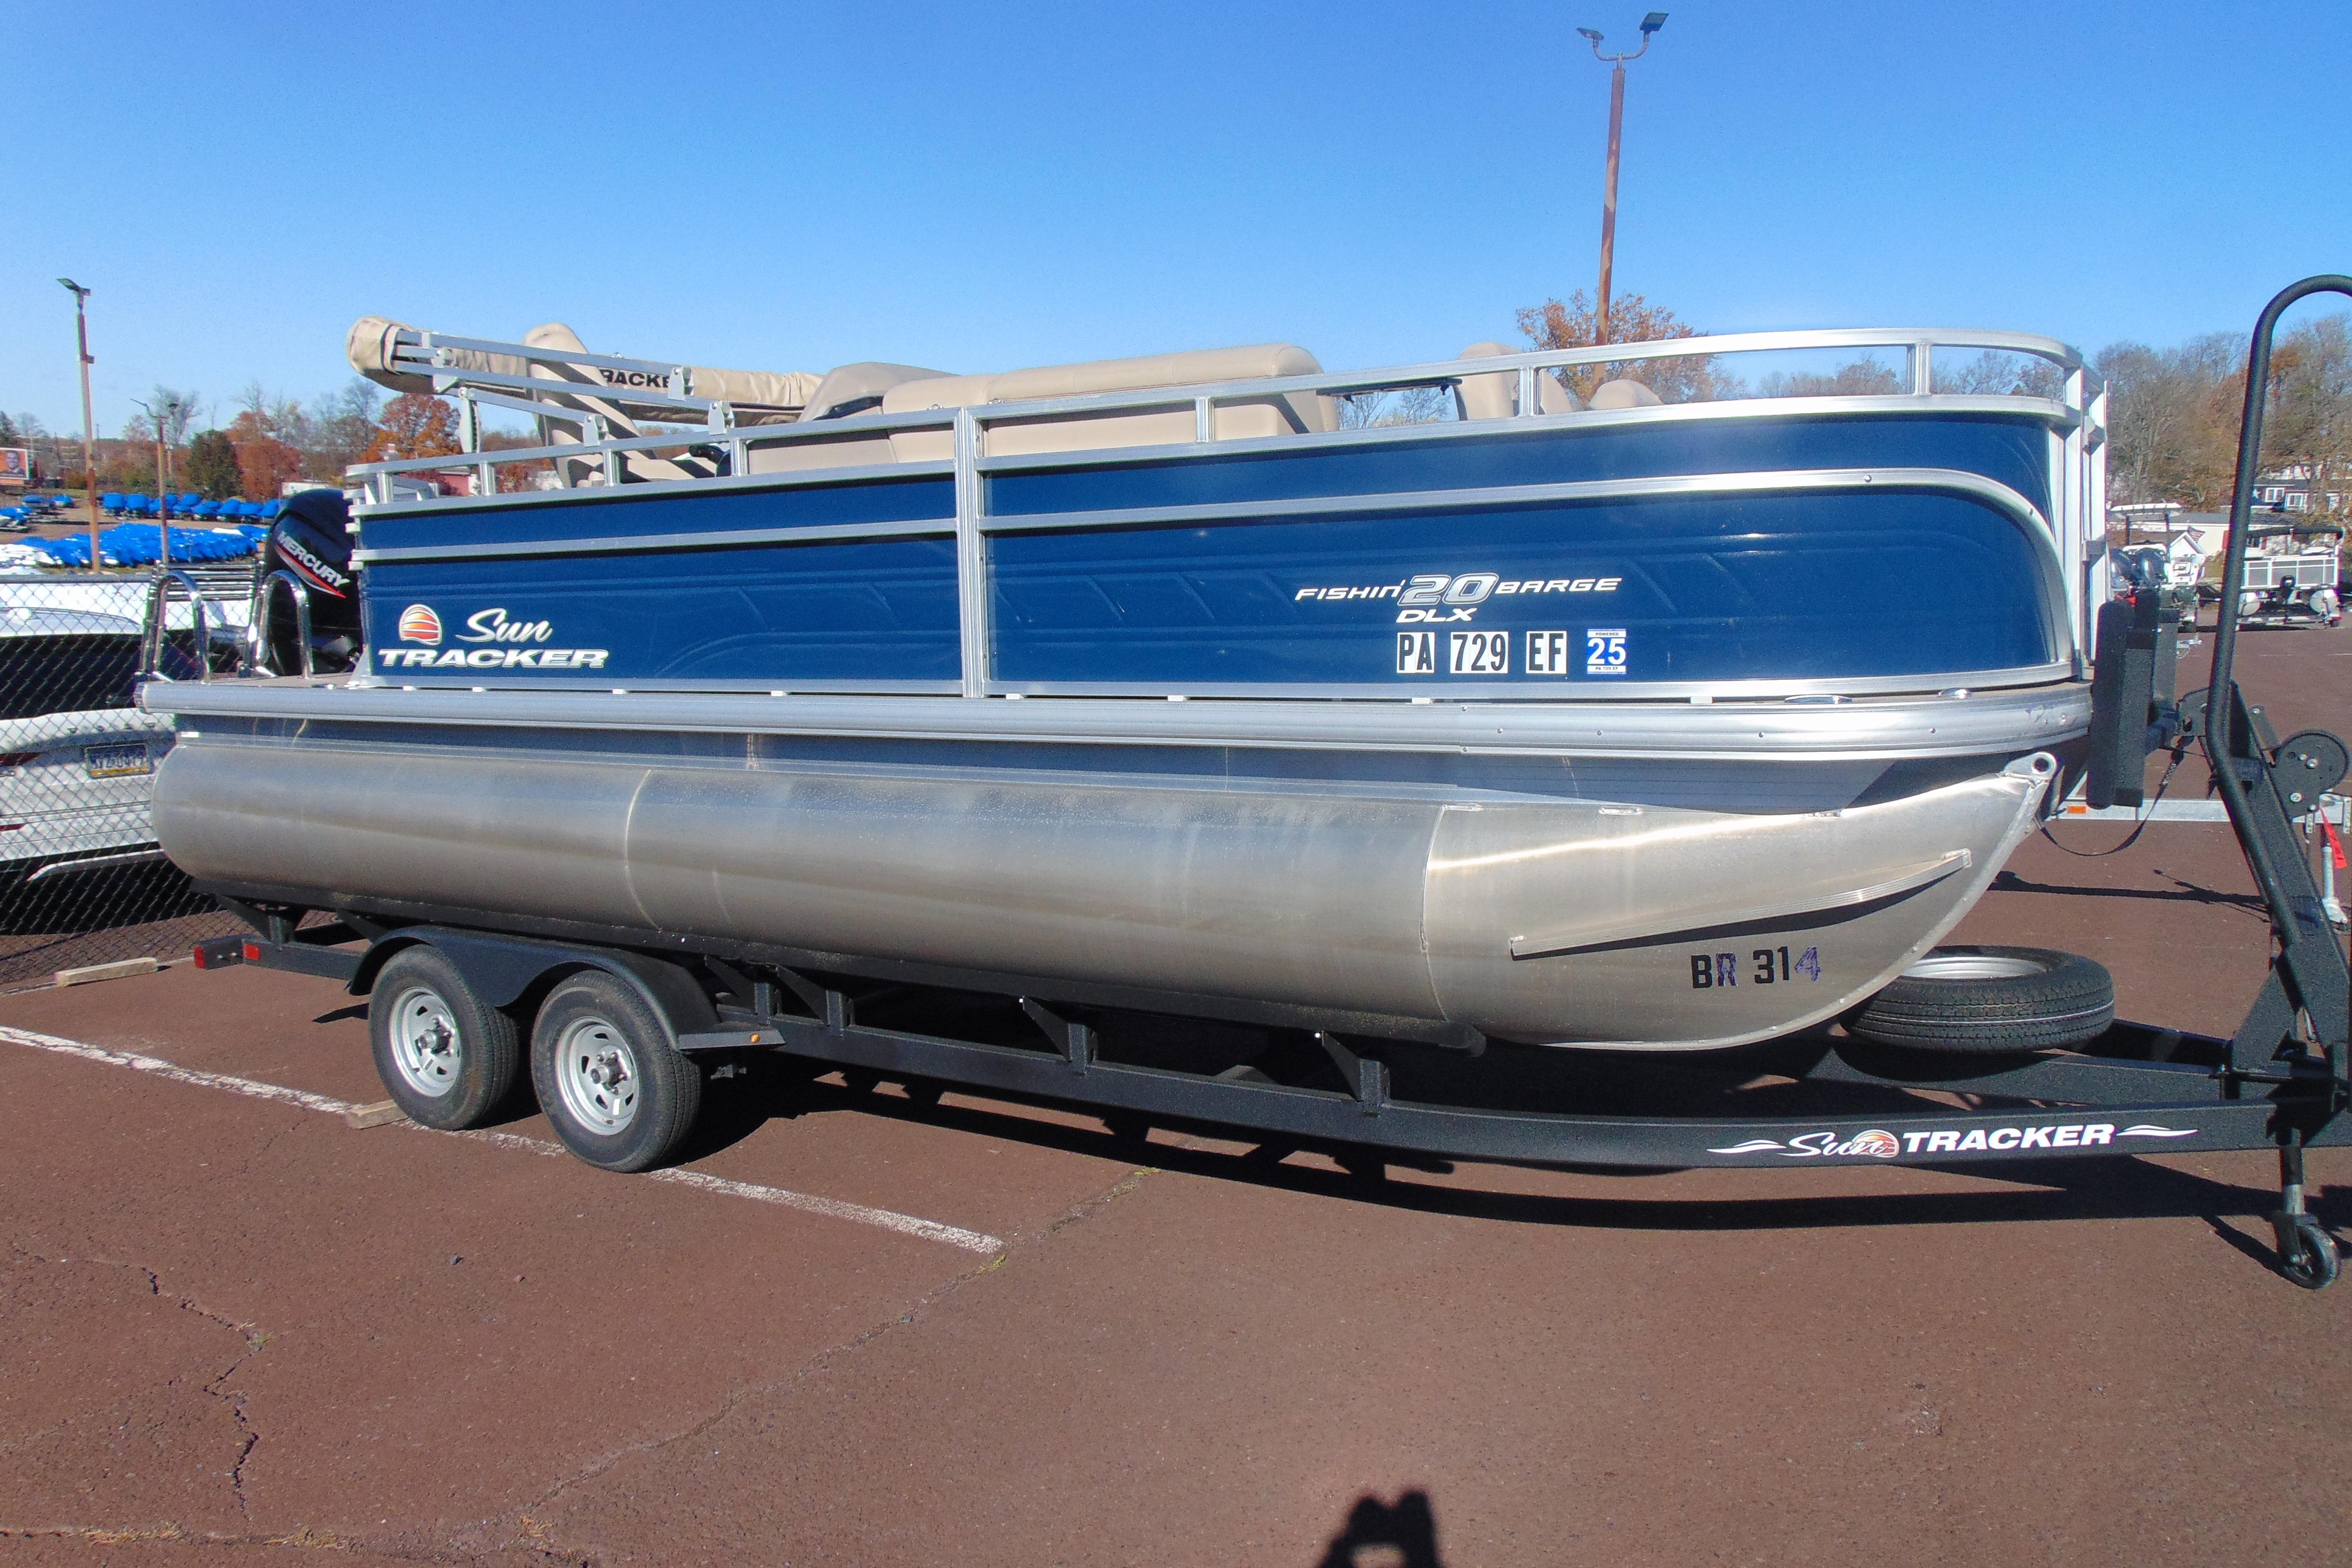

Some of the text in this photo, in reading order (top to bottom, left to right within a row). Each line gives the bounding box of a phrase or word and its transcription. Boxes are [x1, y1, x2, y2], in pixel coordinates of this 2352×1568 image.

[598, 369, 670, 388] RACKE
[277, 530, 351, 587] MERCURY
[1397, 572, 1499, 606] 20
[1495, 577, 1622, 594] BARGE
[455, 608, 553, 643] Sun
[1396, 608, 1477, 623] DLX
[378, 649, 609, 668] TRACKER
[1398, 633, 1564, 671] PA 729 EF
[1587, 638, 1627, 665] 25
[1691, 945, 1822, 989] BR 314
[1776, 1123, 2116, 1157] Sun TRACKER
